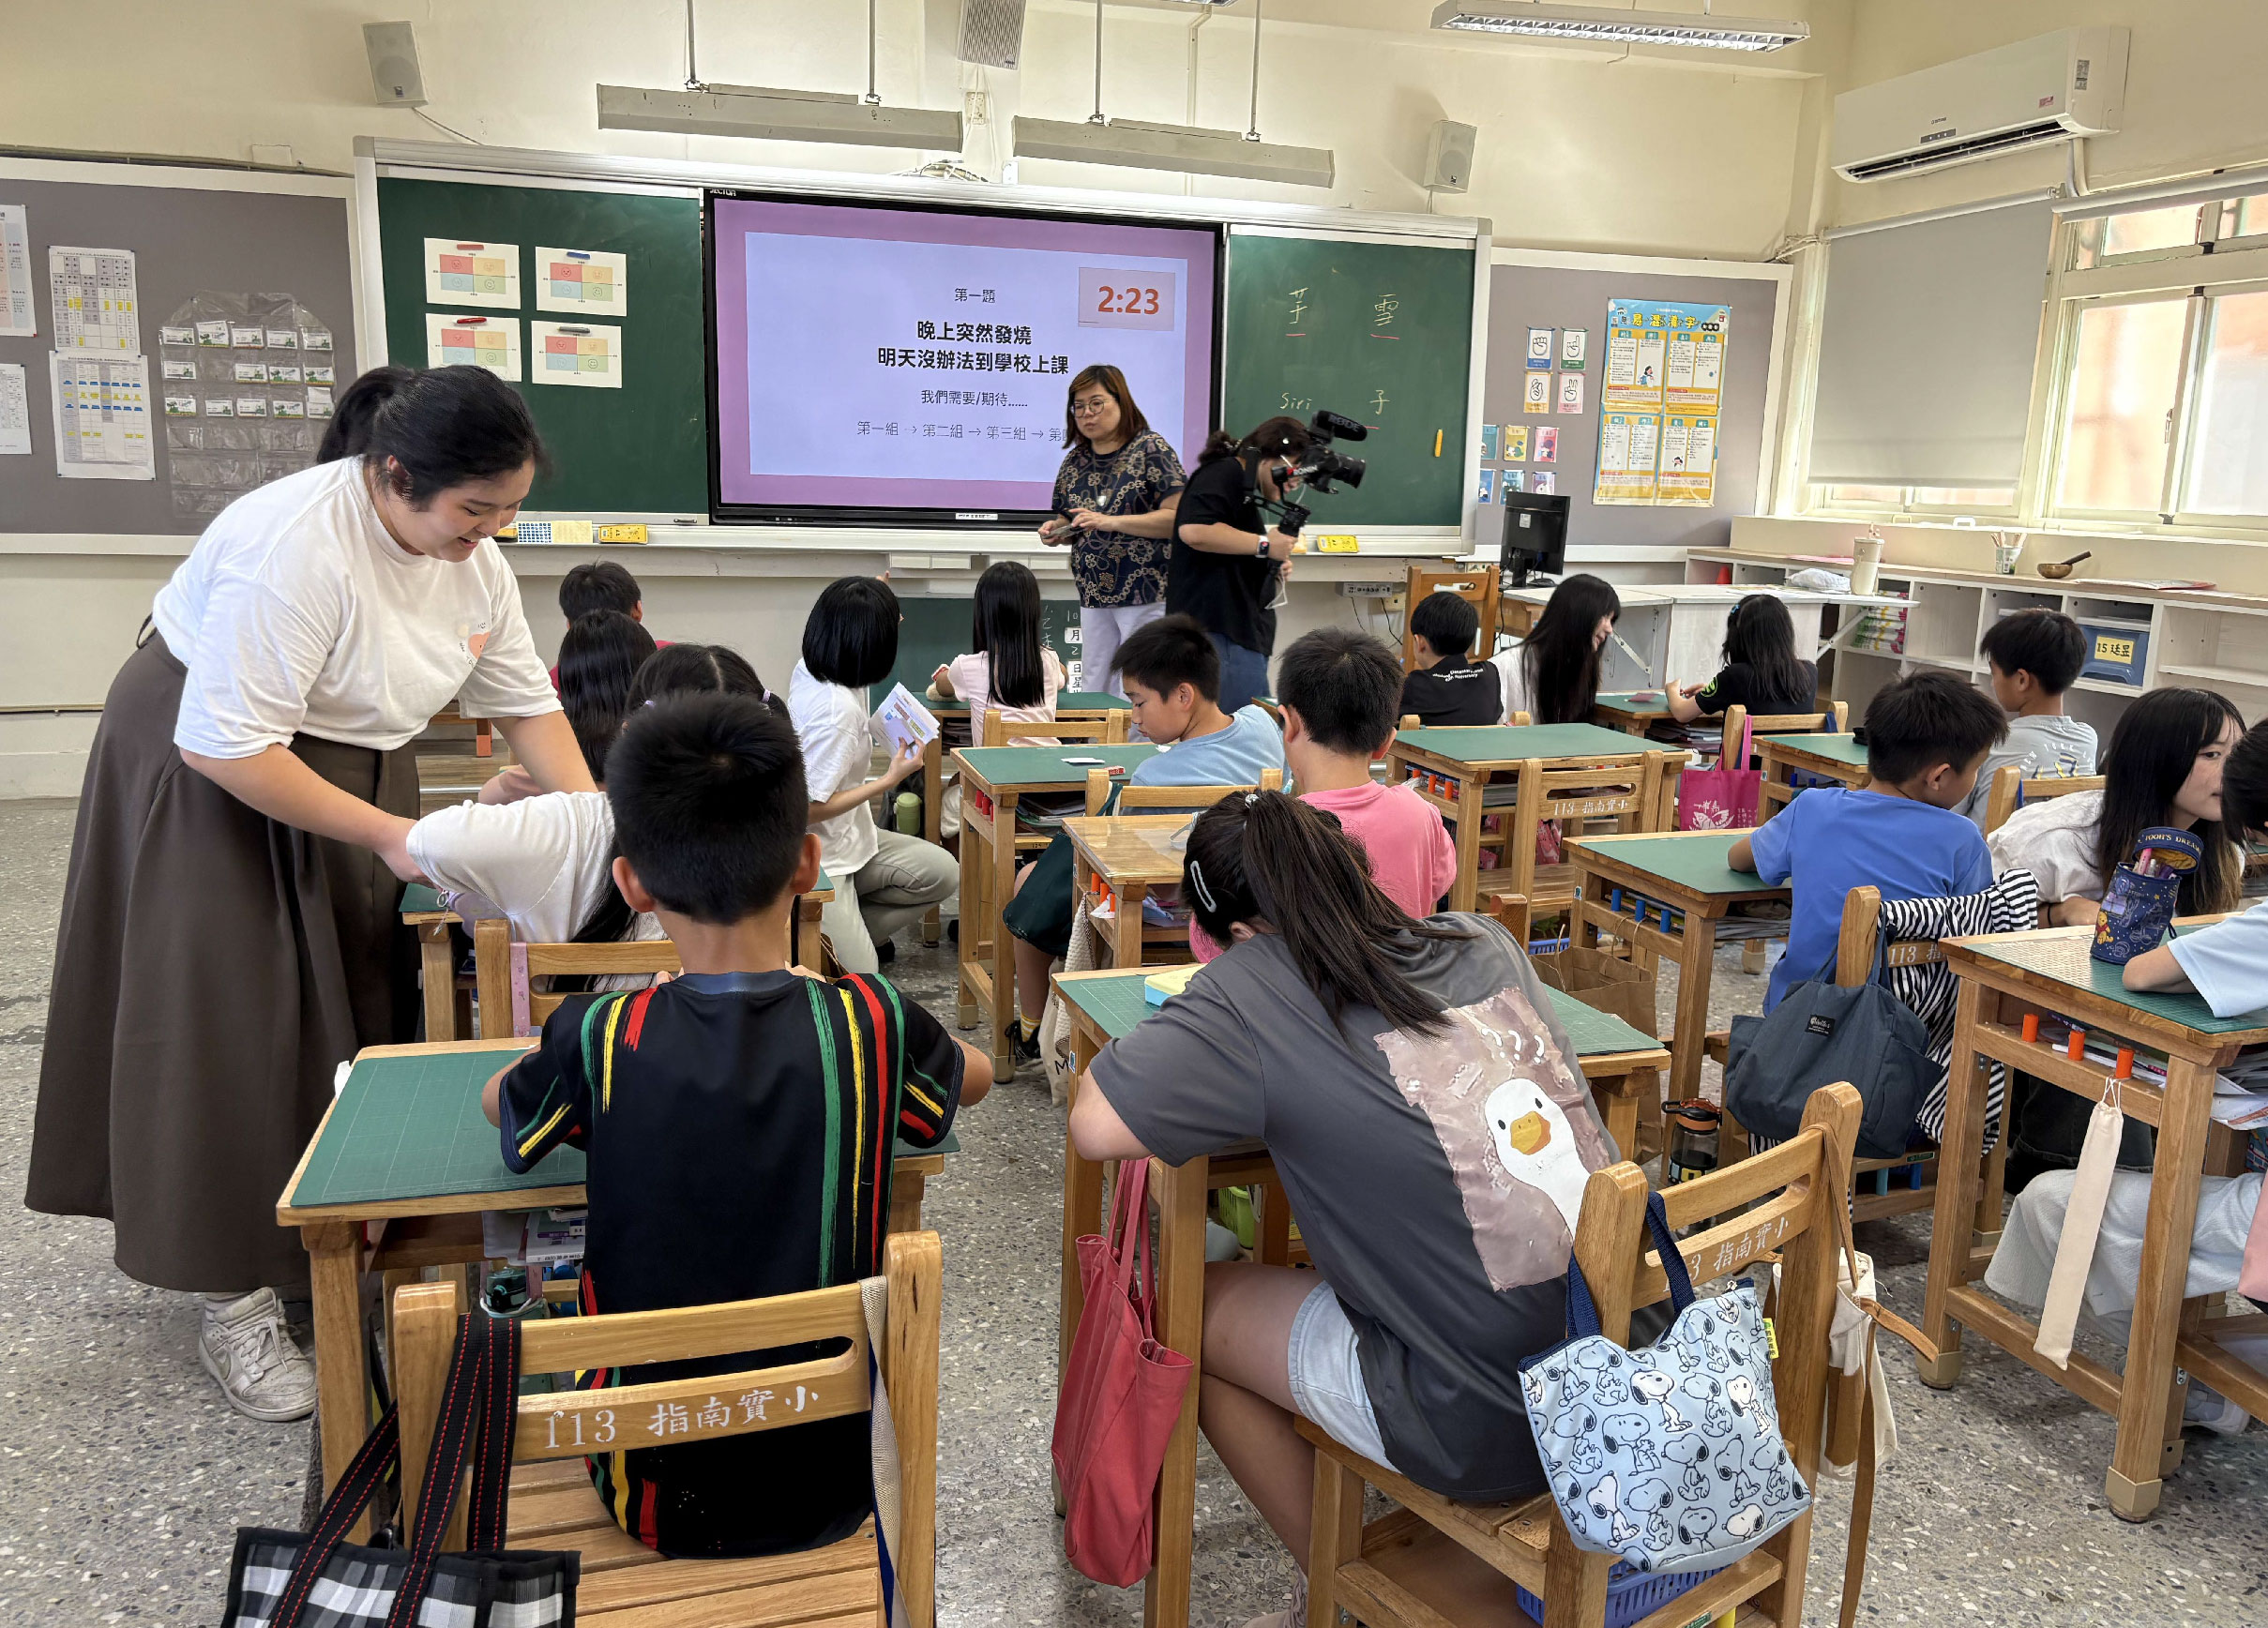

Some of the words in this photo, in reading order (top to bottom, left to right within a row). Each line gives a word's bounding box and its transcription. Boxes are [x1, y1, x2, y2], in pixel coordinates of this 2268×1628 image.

[954, 287, 996, 304] 第一題
[1096, 285, 1159, 315] 2:23
[1373, 293, 1399, 326] 雪
[916, 320, 1033, 346] 晚上突然發燒
[877, 347, 1069, 375] 明天沒辦法到學校上課
[856, 420, 900, 437] 第一組
[922, 422, 963, 439] 第二組
[986, 425, 1027, 441] 第三組
[2096, 642, 2108, 653] 15
[1553, 802, 1575, 816] 113
[1889, 945, 1917, 965] 113
[1713, 1216, 1789, 1272] 指南實小
[544, 1409, 616, 1449] 113
[647, 1385, 819, 1437] 指南實小
